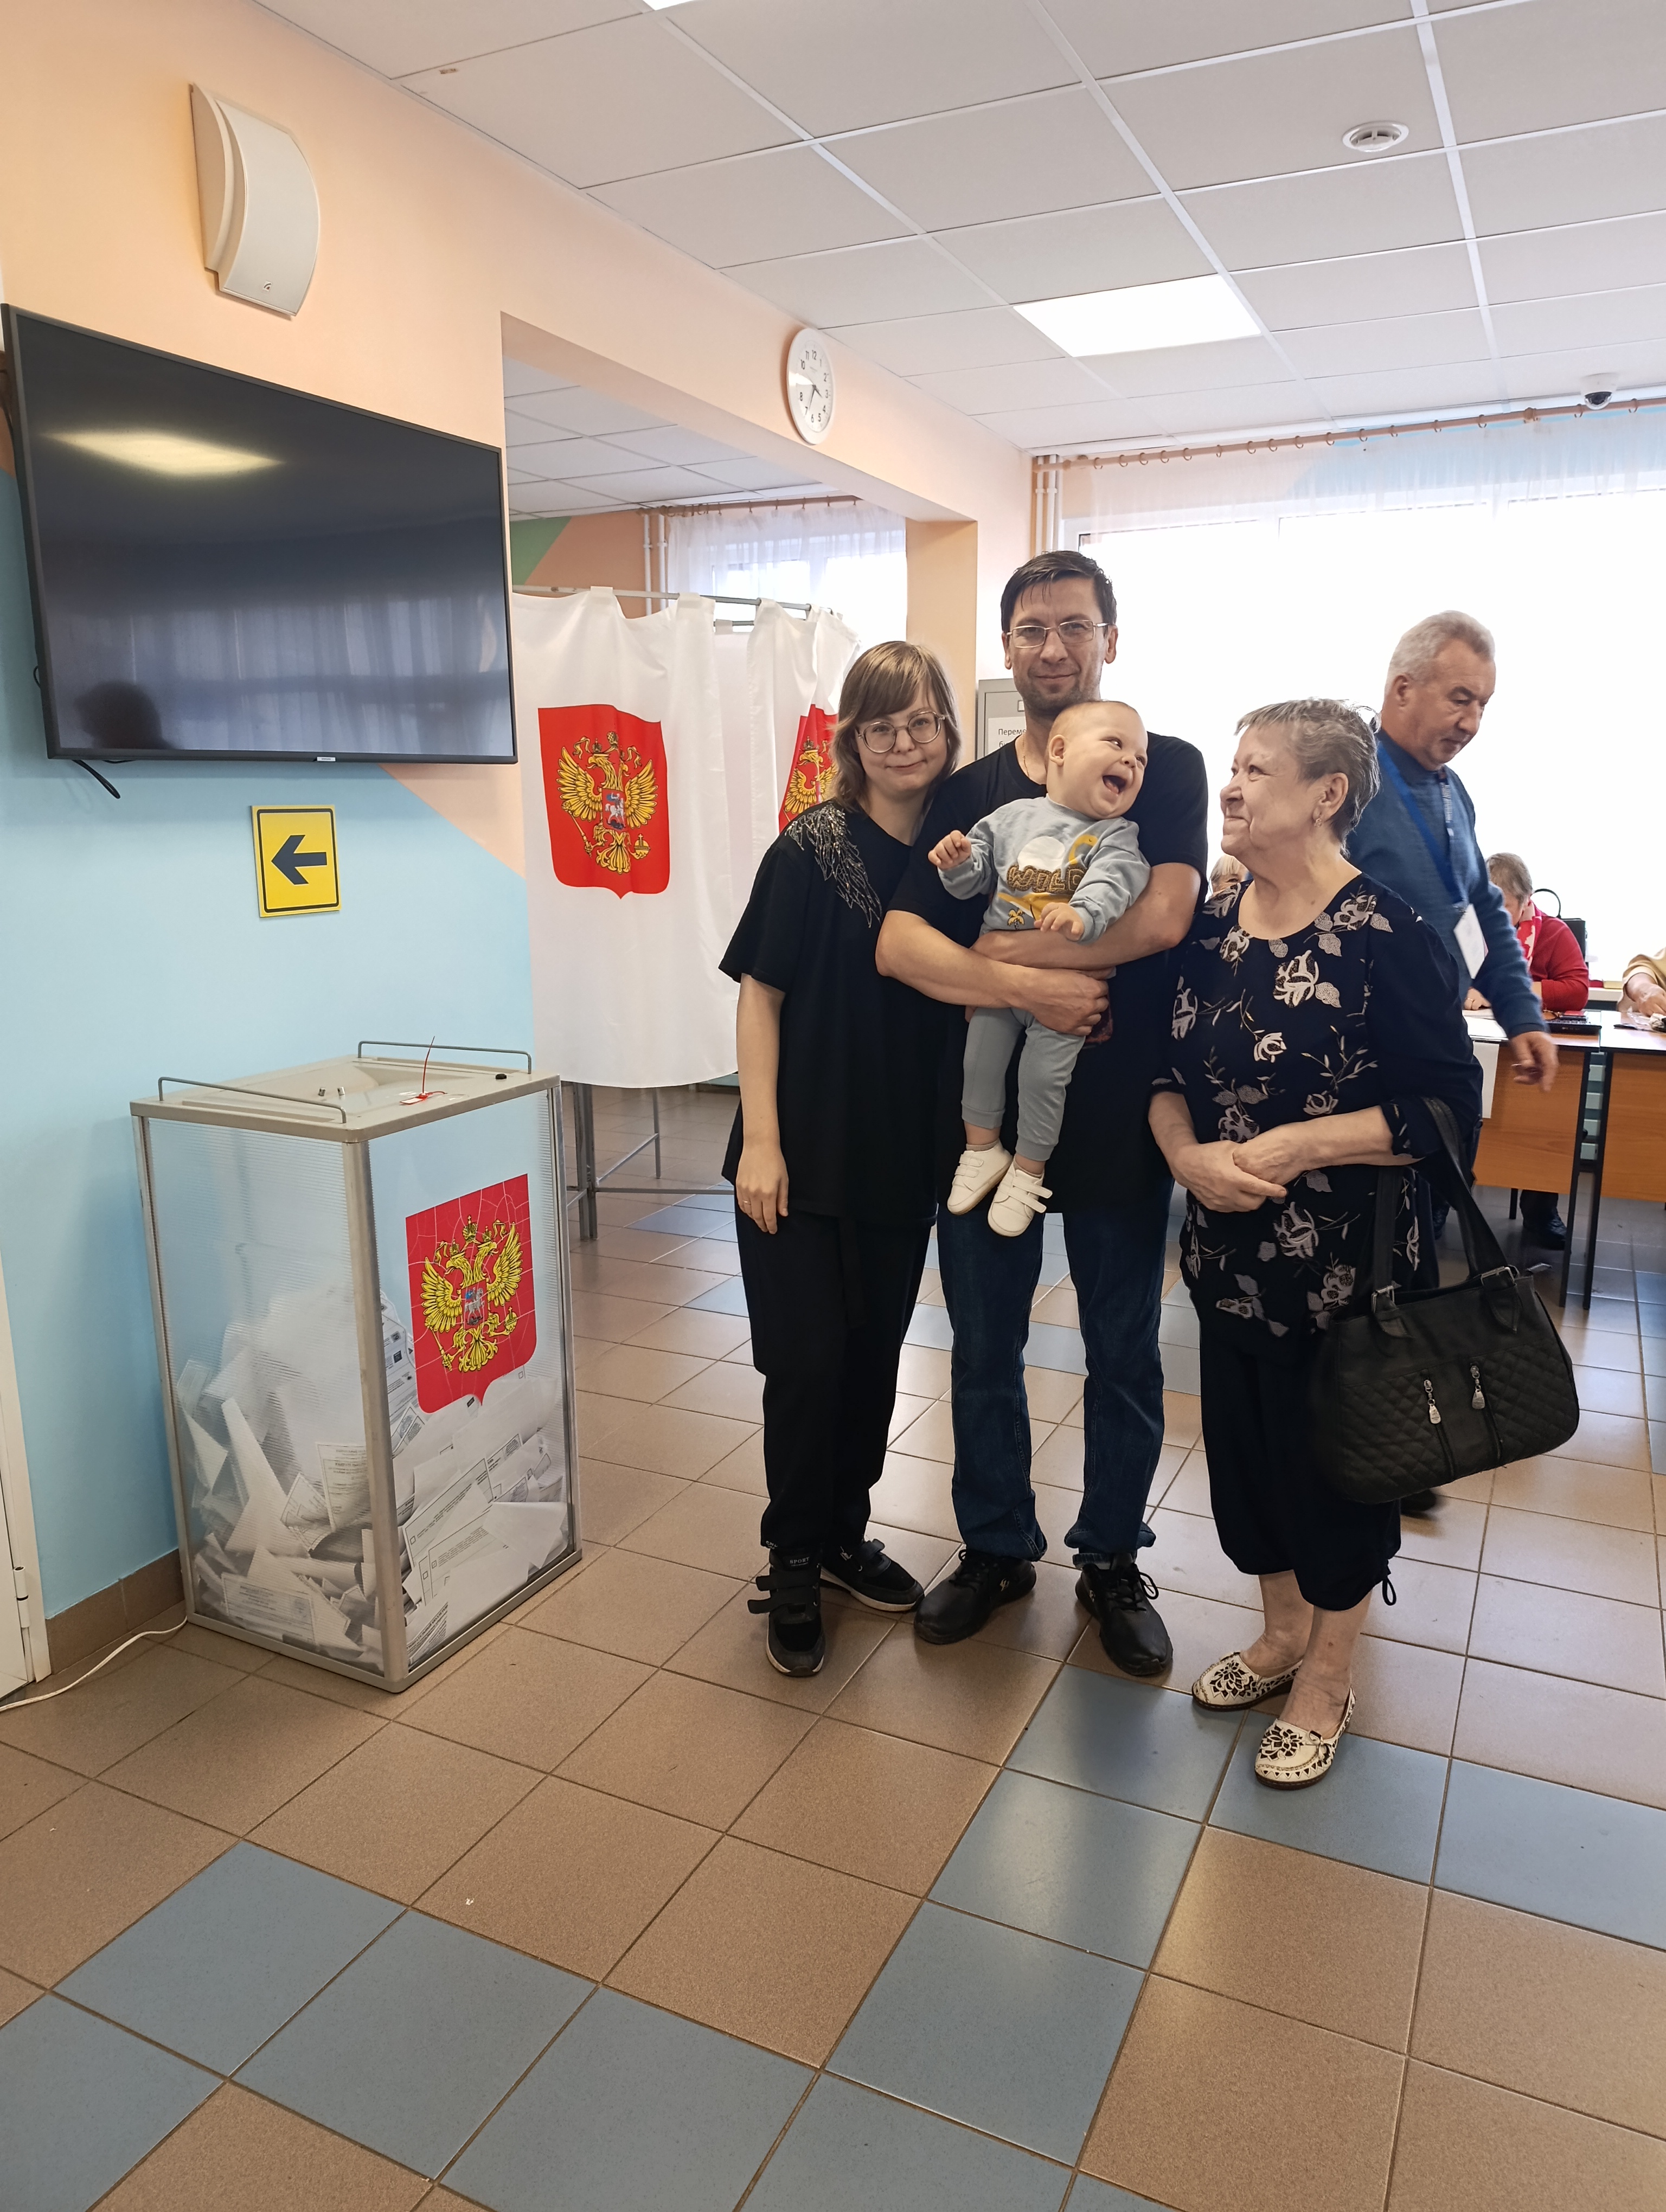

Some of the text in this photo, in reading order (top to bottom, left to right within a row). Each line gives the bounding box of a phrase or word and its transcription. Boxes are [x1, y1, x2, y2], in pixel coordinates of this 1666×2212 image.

[805, 350, 809, 361] 11
[812, 350, 817, 361] 12
[800, 359, 805, 370] 10
[799, 391, 803, 401] 8
[825, 389, 829, 398] 3
[805, 406, 808, 416] 7
[823, 404, 826, 413] 4
[811, 414, 815, 423] 6
[818, 413, 822, 422] 5
